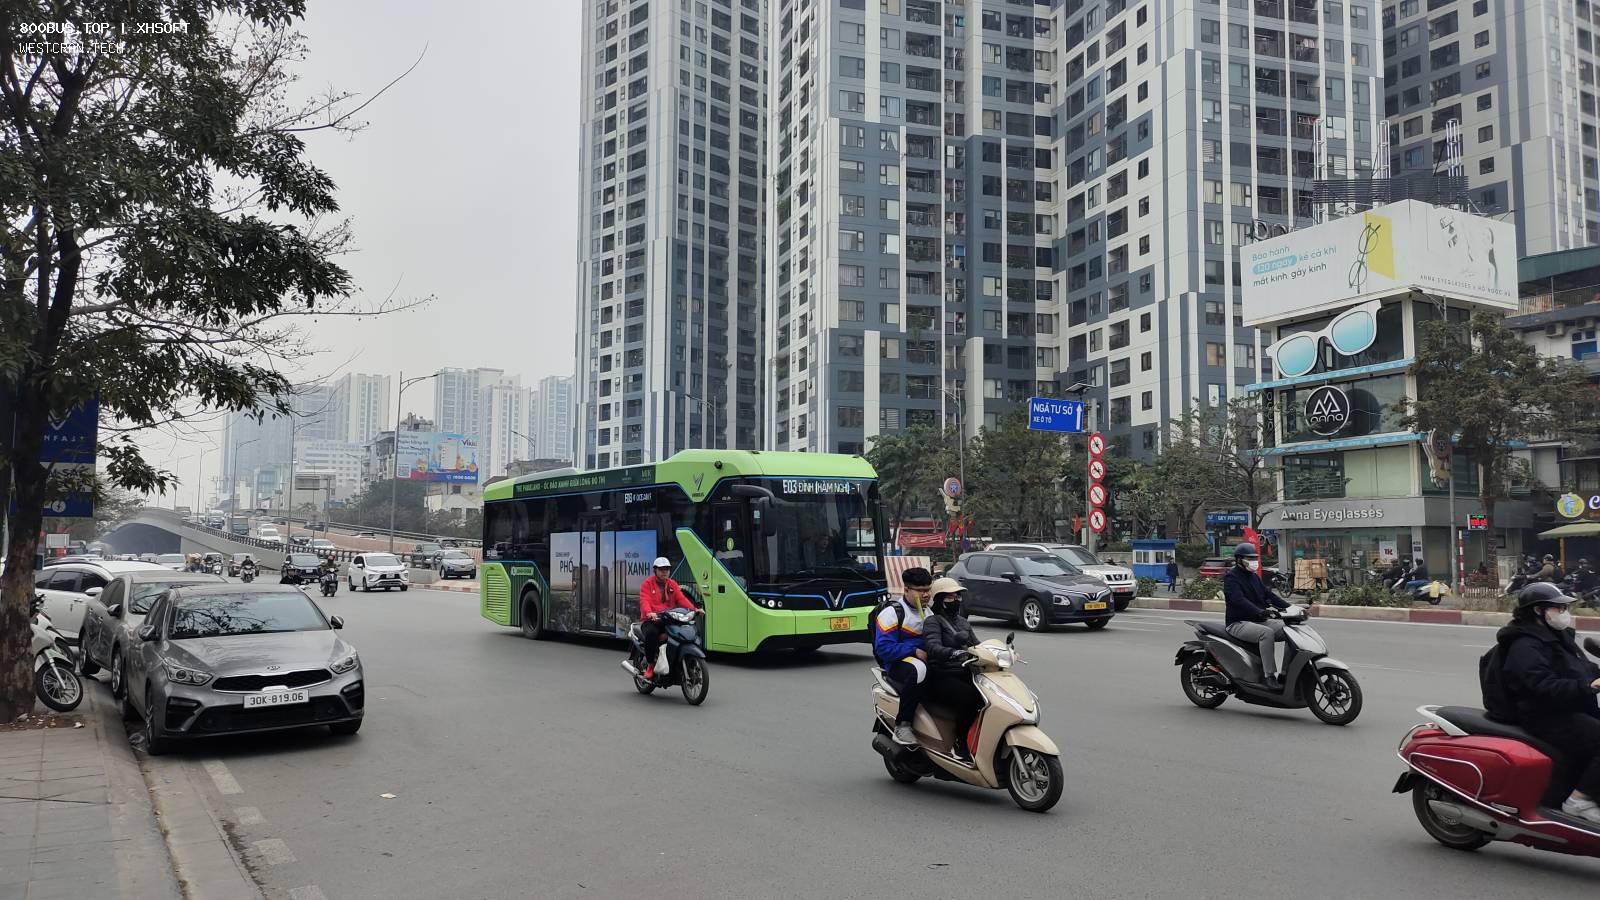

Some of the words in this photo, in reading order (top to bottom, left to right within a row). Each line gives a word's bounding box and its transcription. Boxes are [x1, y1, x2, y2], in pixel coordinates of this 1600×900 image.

[1034, 403, 1049, 413] NGÃ
[1051, 405, 1061, 414] TƯ
[1280, 510, 1310, 521] Anna
[1313, 508, 1384, 523] Eyeglasses
[627, 560, 651, 577] XANH
[250, 693, 303, 705] 30K-819.06
